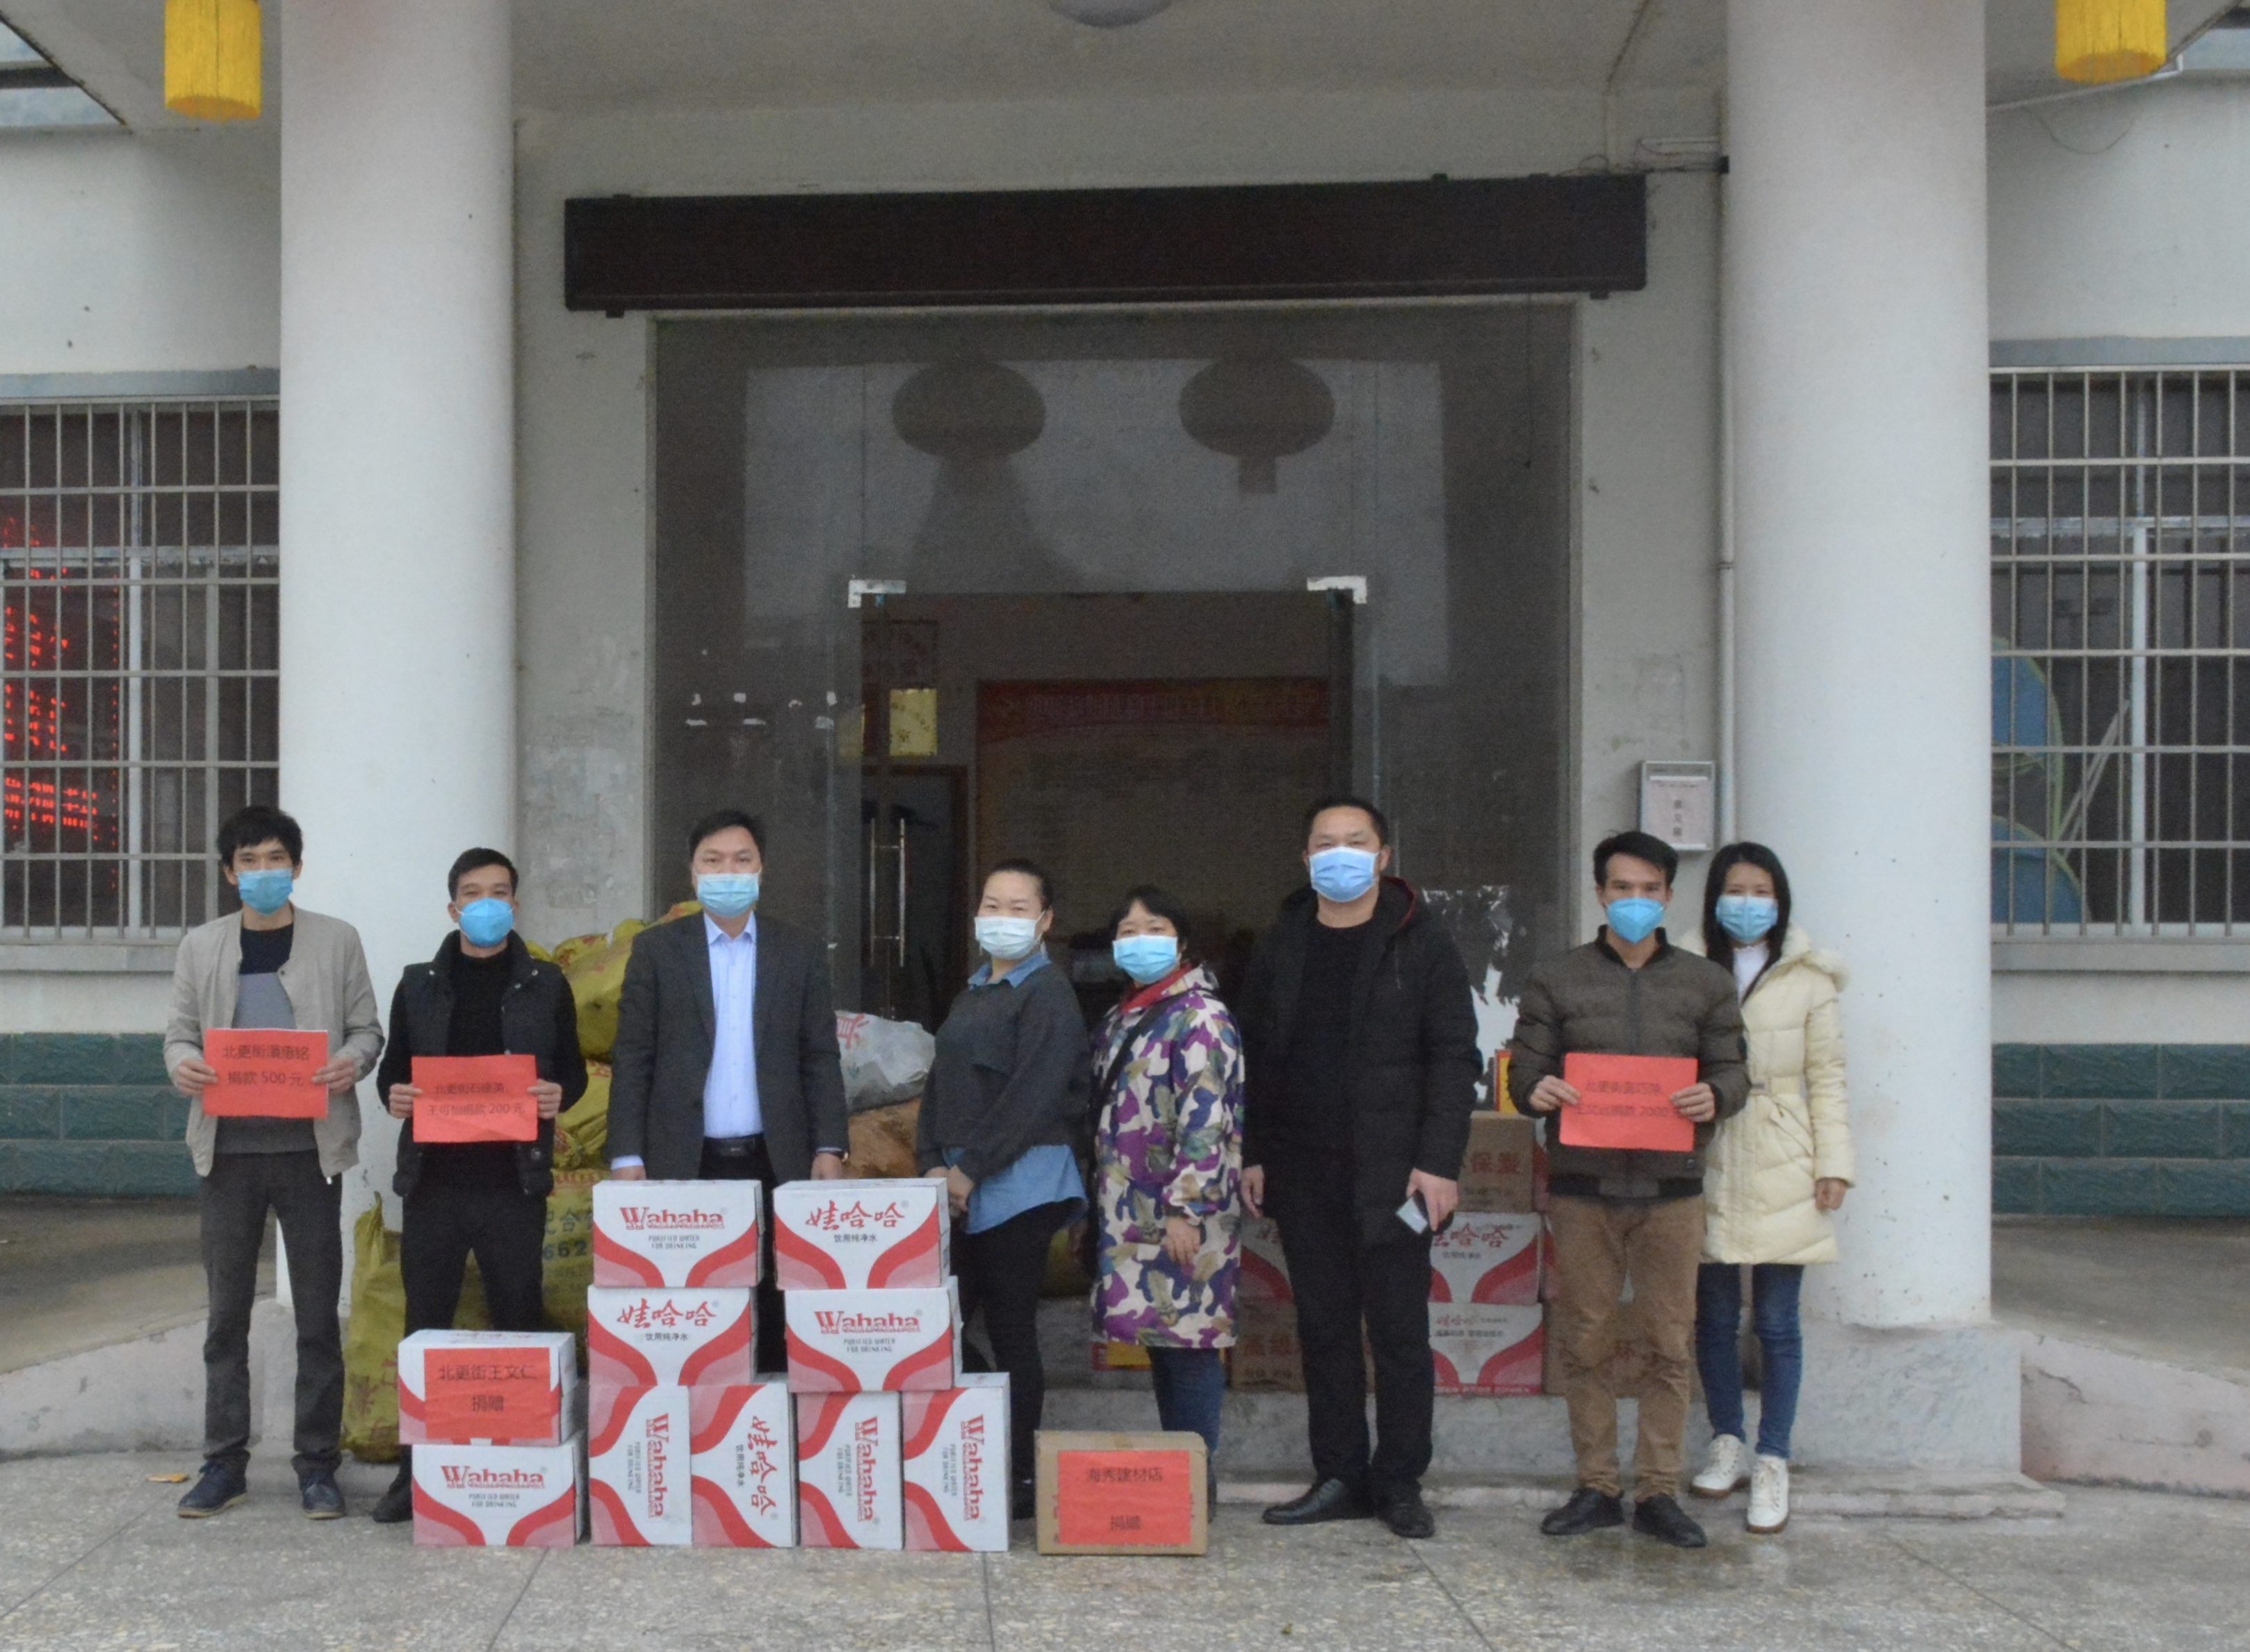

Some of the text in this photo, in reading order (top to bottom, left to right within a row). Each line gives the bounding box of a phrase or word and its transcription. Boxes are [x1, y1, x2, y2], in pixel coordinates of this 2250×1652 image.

[261, 1071, 286, 1083] 500
[289, 1072, 304, 1086] 元
[489, 1103, 510, 1114] 200
[514, 1102, 525, 1115] 元
[619, 1207, 724, 1229] Wahaha
[805, 1200, 904, 1231] 娃哈哈
[834, 1234, 877, 1243] 饮用纯净水
[617, 1298, 716, 1329] 娃哈哈
[814, 1310, 921, 1334] Wahaha
[646, 1332, 688, 1341] 饮用纯净水
[438, 1364, 537, 1381] 北更街王文仁
[471, 1395, 504, 1412] 捐赠
[441, 1465, 545, 1489] Wahaha
[646, 1412, 669, 1519] Wahaha
[748, 1416, 778, 1516] 娃哈哈
[856, 1416, 879, 1521] Wahaha
[961, 1414, 984, 1521] Wahaha
